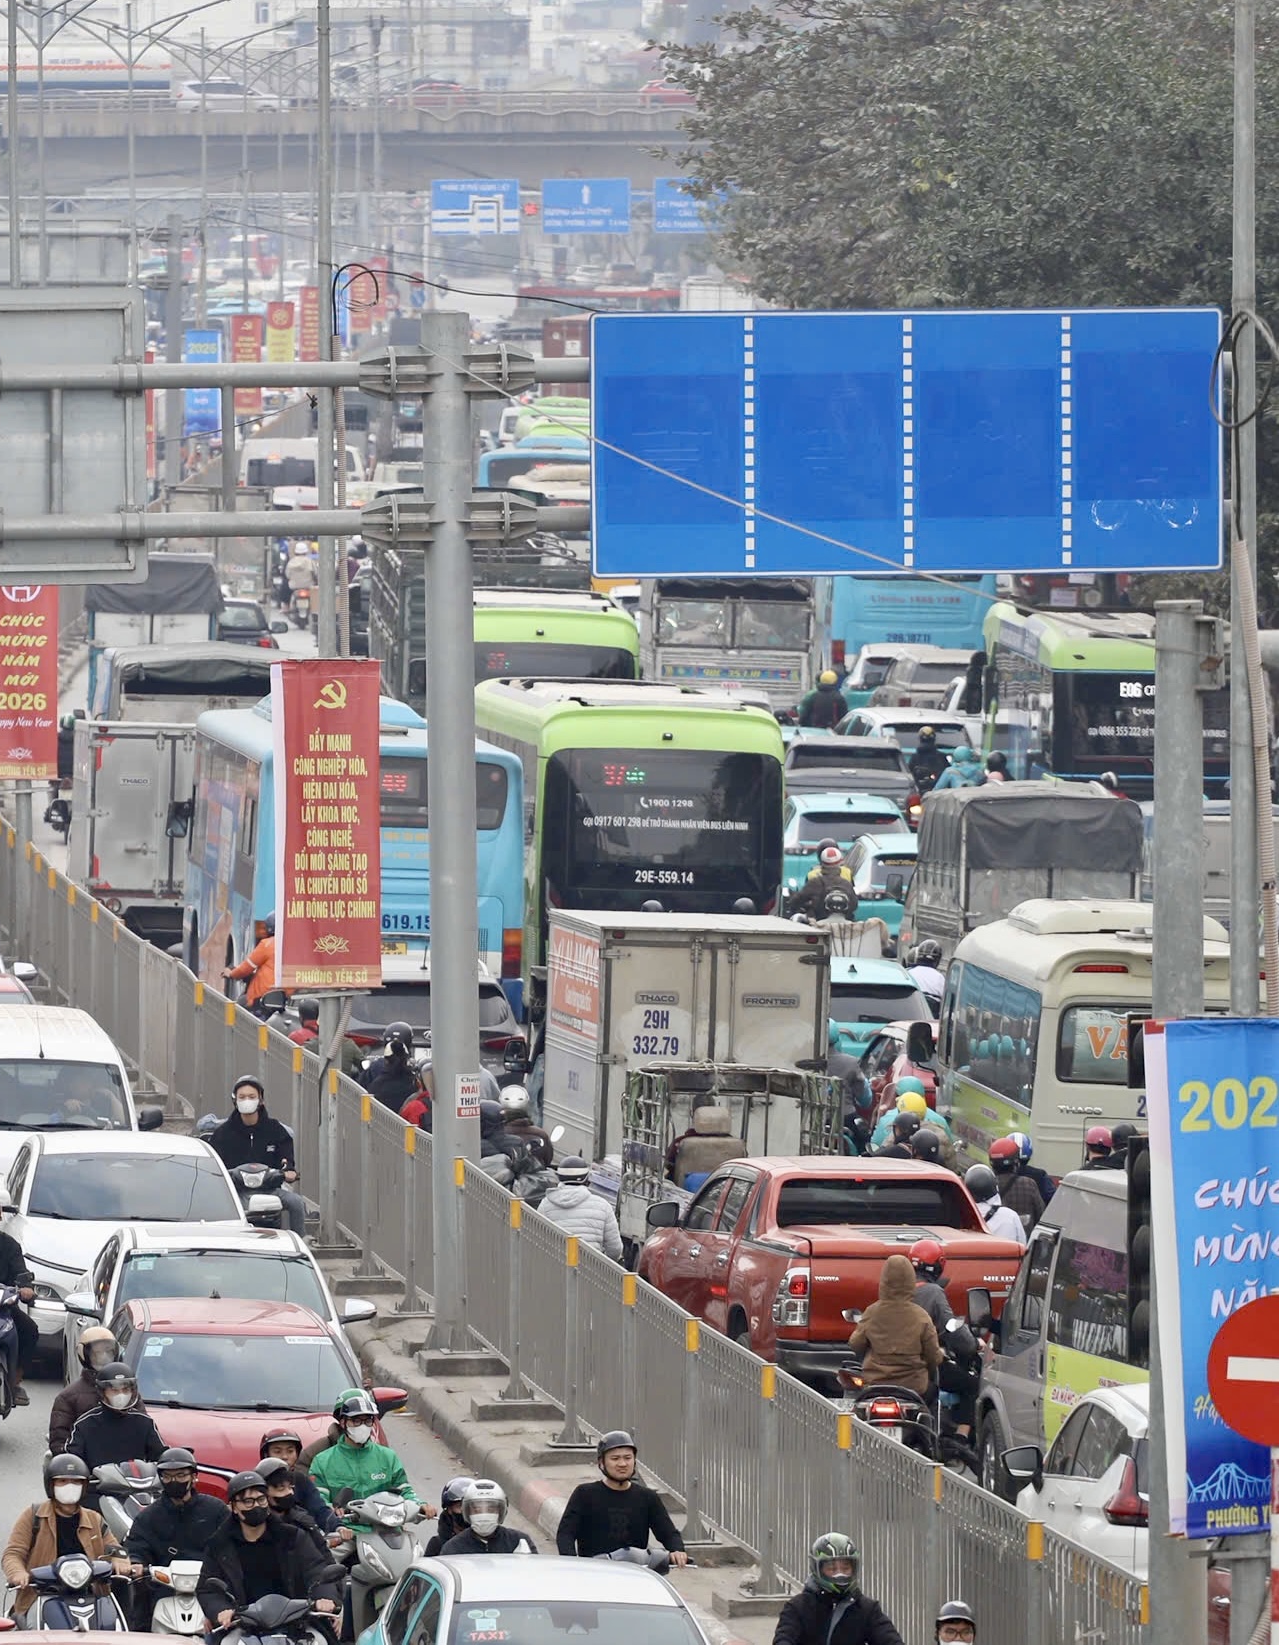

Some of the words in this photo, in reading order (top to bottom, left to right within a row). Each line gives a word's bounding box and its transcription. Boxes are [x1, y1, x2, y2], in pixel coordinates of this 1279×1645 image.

[0, 612, 46, 628] CHÚC
[1, 651, 41, 667] NĂM
[3, 671, 39, 687] MỚI
[1120, 682, 1142, 698] E06
[15, 716, 33, 727] New
[35, 717, 53, 727] Year
[293, 754, 316, 775] CÔNG
[648, 799, 670, 807] 1900
[672, 799, 694, 807] 1298
[317, 805, 339, 823] KHOA
[594, 815, 612, 827] 0917
[613, 816, 626, 827] 601
[627, 816, 641, 827] 298
[306, 826, 329, 847] CÔNG
[327, 849, 350, 871] SÁNG
[634, 869, 694, 884] 29E-559.14
[287, 897, 304, 918] LÀM
[347, 897, 376, 918] CHÍNH!
[295, 969, 333, 983] PHƯỜNG
[335, 968, 353, 983] YÊN
[355, 967, 368, 982] SỞ
[639, 994, 675, 1002] THACO
[745, 997, 796, 1006] FRONTIER
[643, 1010, 669, 1030] 29H
[633, 1036, 679, 1056] 332.79
[1057, 1104, 1103, 1115] THACO
[371, 1472, 386, 1480] Grab
[1206, 1503, 1258, 1530] PHƯỜNG
[470, 1631, 505, 1641] TAXI
